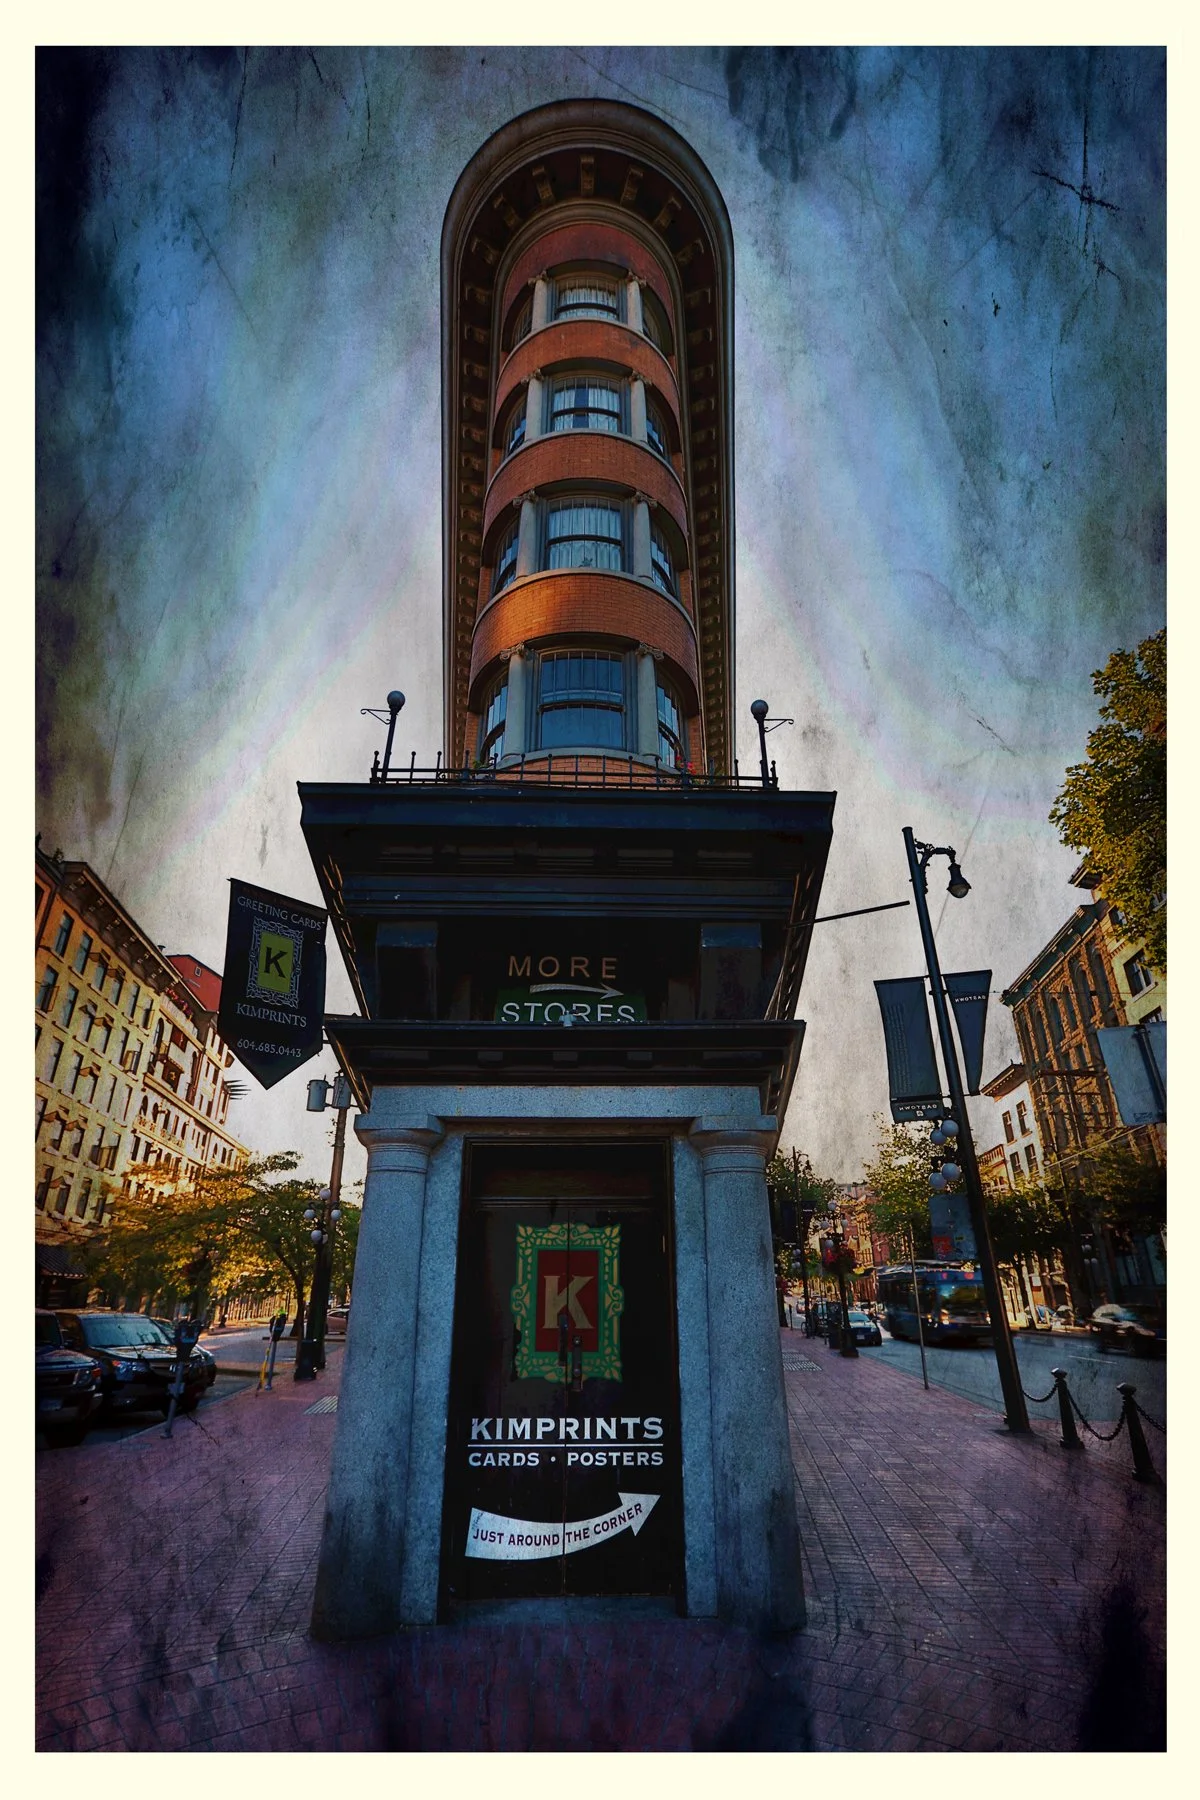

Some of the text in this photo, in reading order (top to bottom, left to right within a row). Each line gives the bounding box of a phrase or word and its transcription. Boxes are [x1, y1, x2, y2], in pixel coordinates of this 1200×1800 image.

[237, 895, 322, 931] GREETING CARDS
[263, 946, 288, 979] K
[508, 955, 617, 979] MORE
[236, 1002, 307, 1028] KIMPRINTS
[501, 1002, 635, 1022] STORES
[237, 1038, 302, 1058] 604.685.0443
[542, 1275, 595, 1330] K
[471, 1417, 664, 1440] KIMPRINTS
[468, 1451, 664, 1467] CARDS POSTERS
[473, 1503, 643, 1547] JUST AROUND THE CORNER
